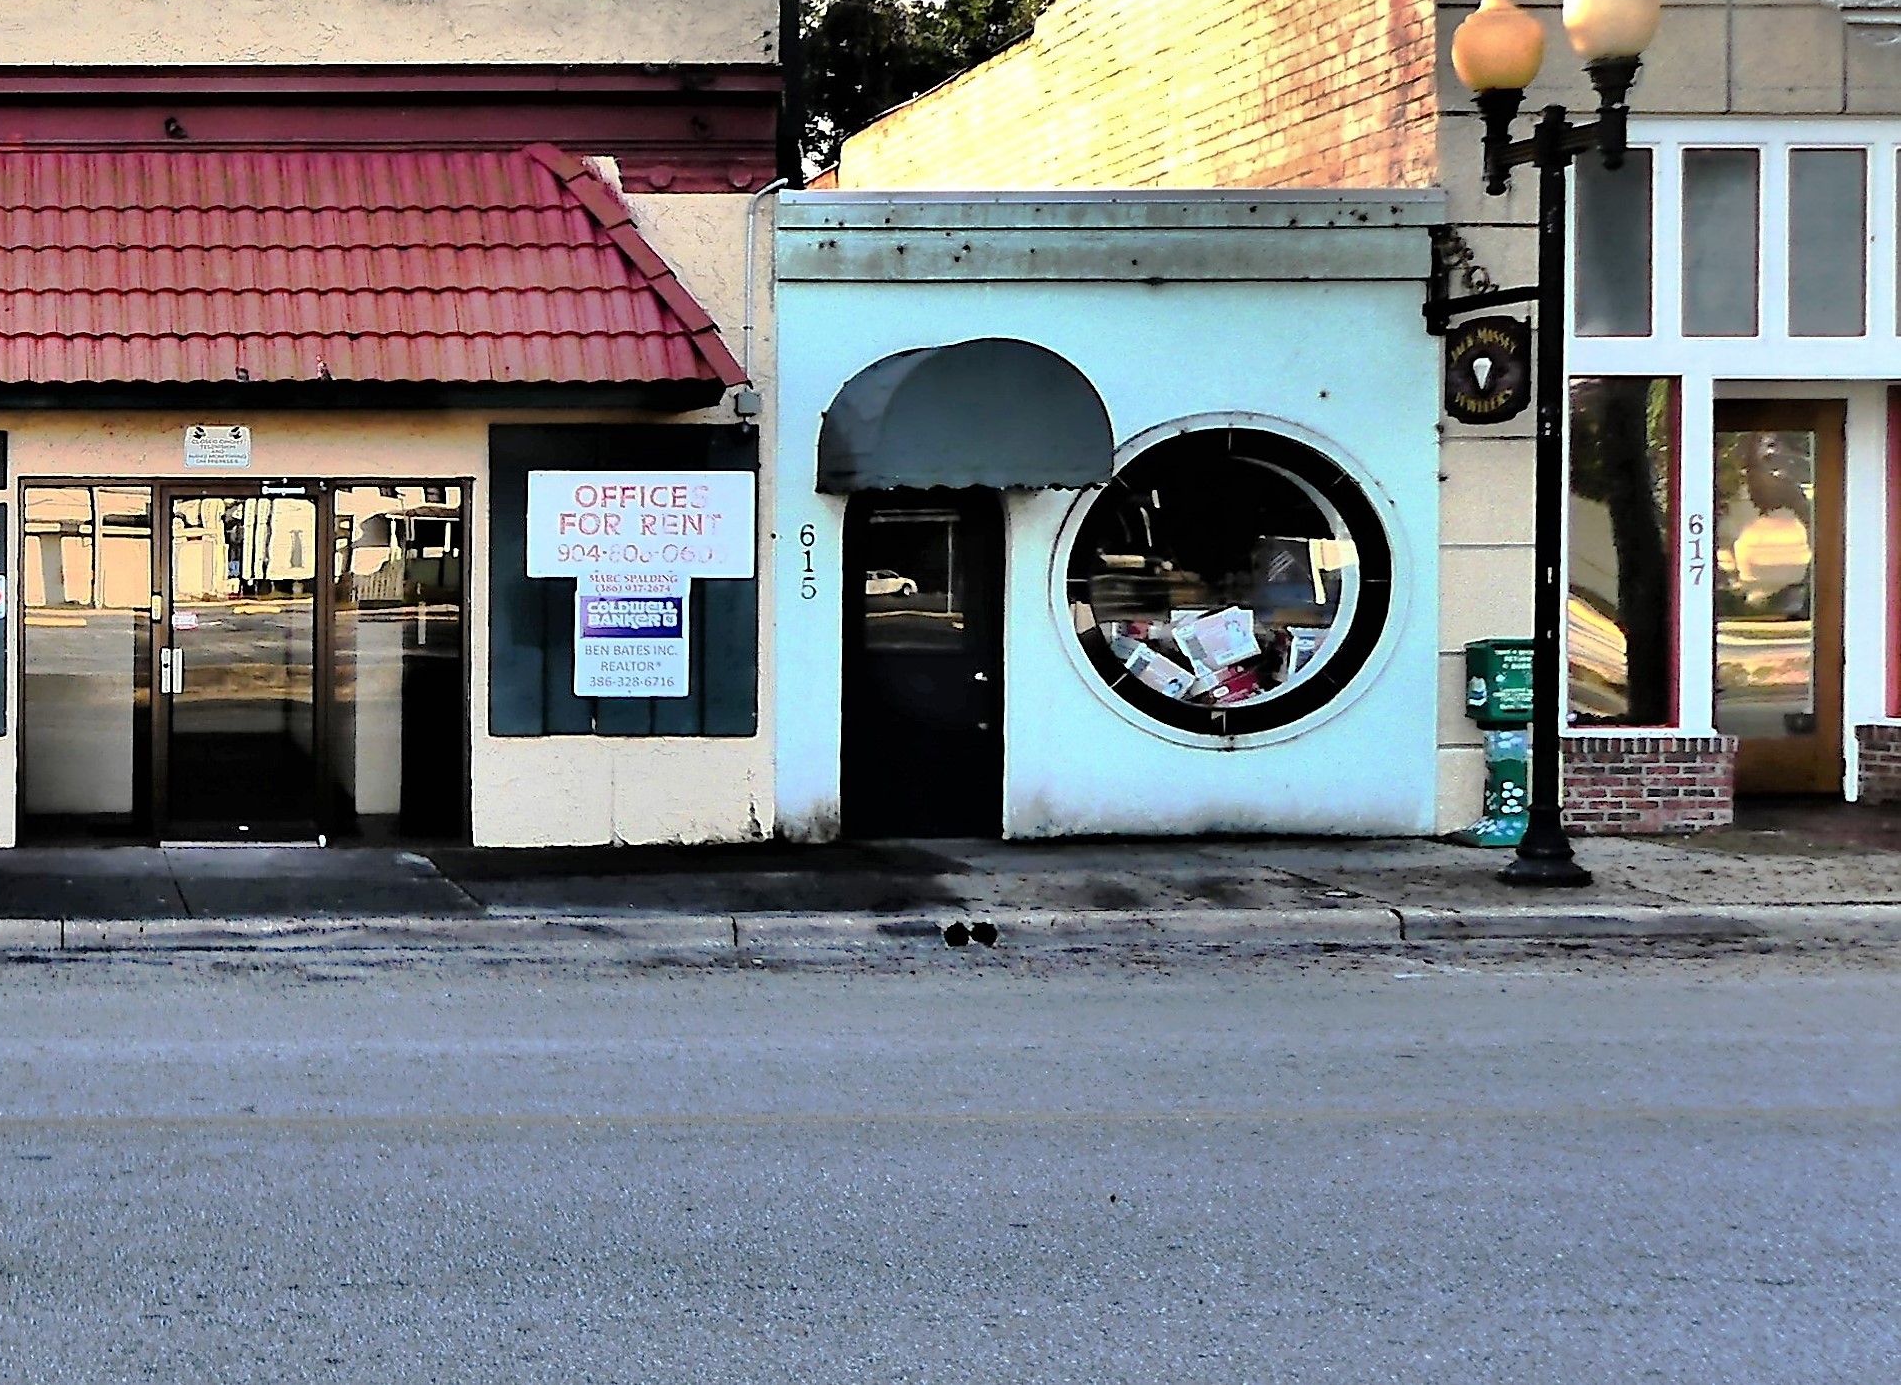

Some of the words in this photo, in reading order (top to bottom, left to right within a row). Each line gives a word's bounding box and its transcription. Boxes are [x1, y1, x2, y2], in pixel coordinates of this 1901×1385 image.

[574, 484, 710, 509] OFFICES
[559, 513, 622, 536] FOR
[640, 513, 722, 536] RENT
[1688, 513, 1706, 586] 617
[800, 524, 817, 600] 615
[590, 575, 620, 583] MARC
[624, 575, 678, 583] SPALDING
[587, 601, 678, 614] COLDWELL
[588, 614, 662, 628] BANKER
[585, 645, 610, 656] BEN
[613, 645, 651, 656] BATES
[653, 645, 678, 656] INC.
[589, 676, 675, 687] 386-328-6716
